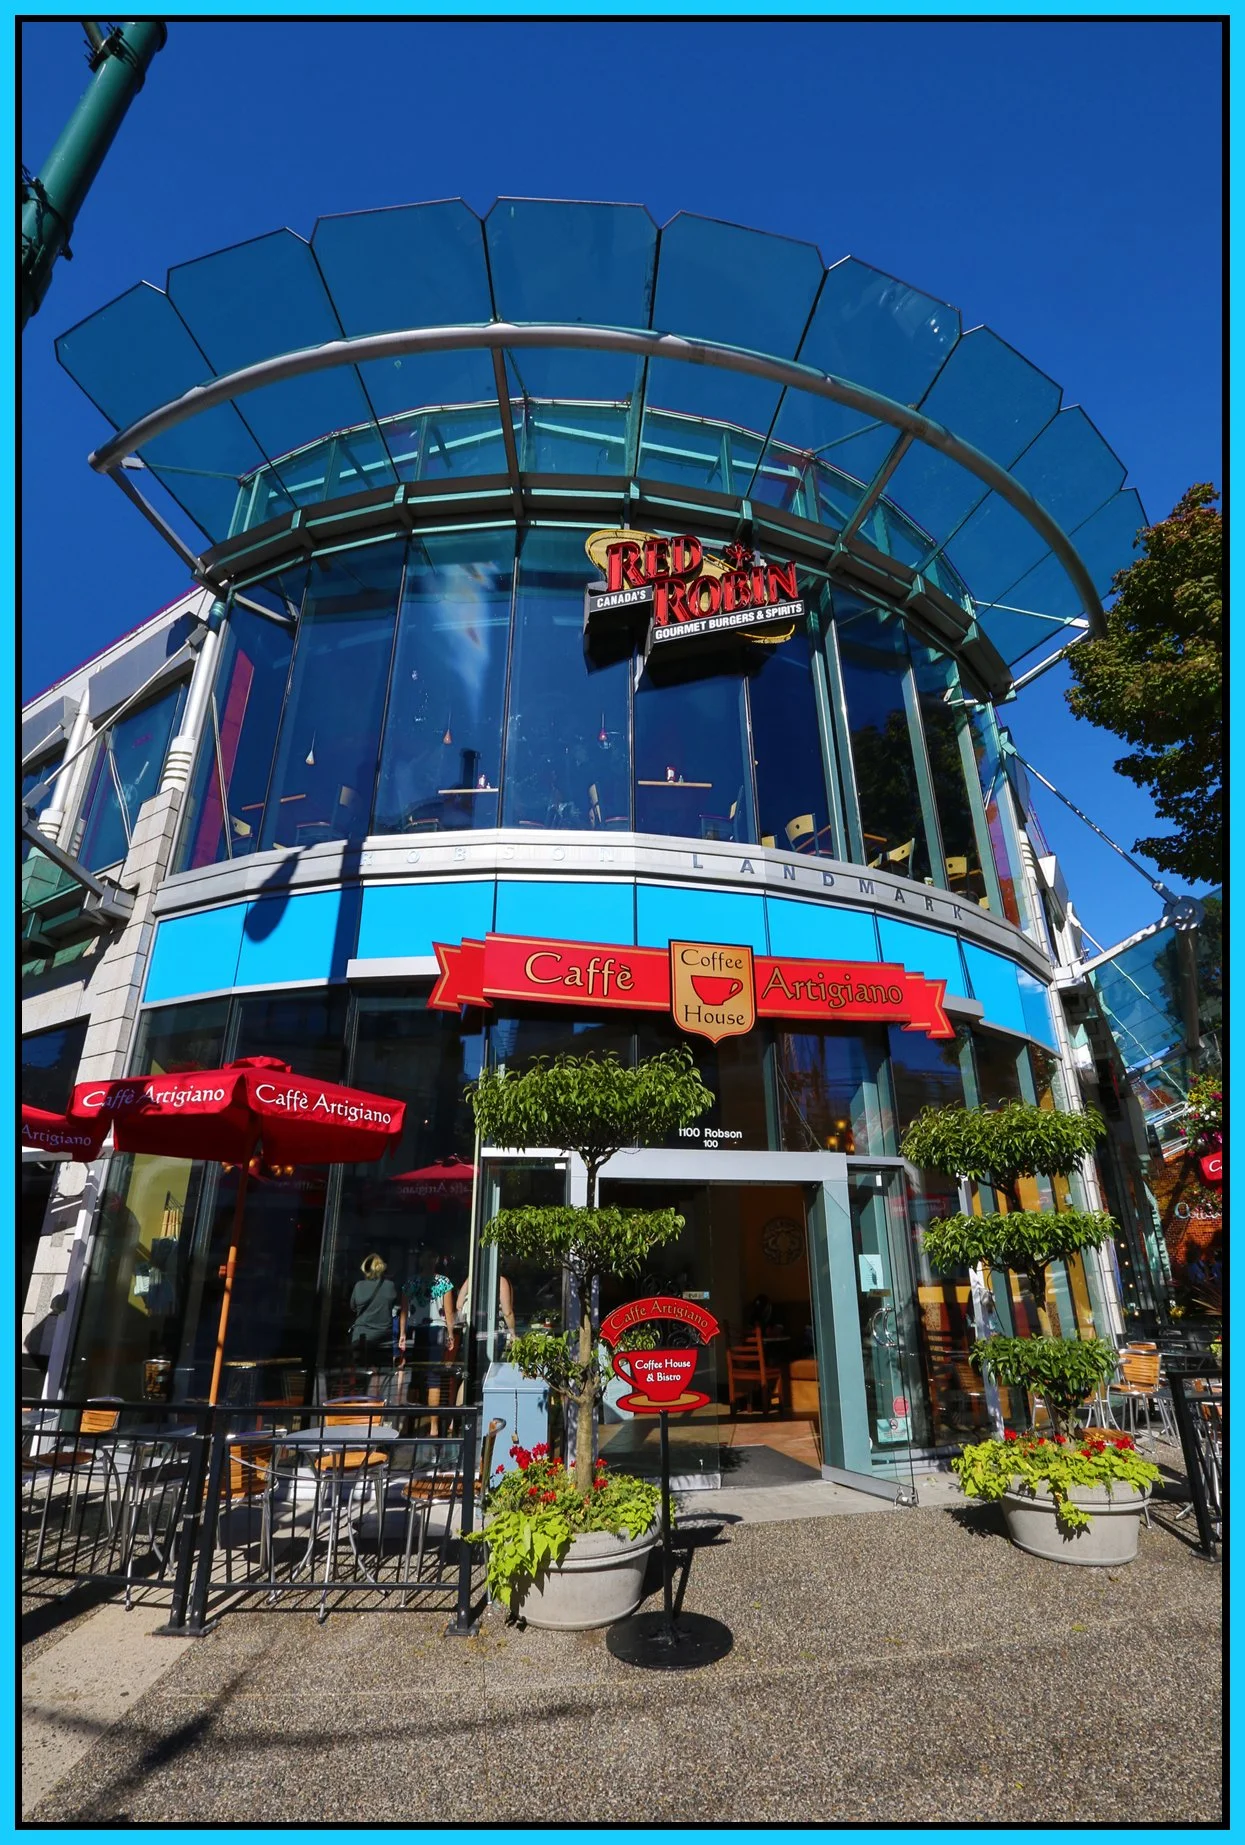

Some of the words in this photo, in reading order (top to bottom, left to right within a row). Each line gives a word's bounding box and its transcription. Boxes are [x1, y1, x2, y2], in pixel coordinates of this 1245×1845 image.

[606, 534, 704, 593] RED
[596, 589, 647, 608] CANADA'S
[652, 560, 799, 627] ROBIN
[655, 620, 707, 641] GOURMET
[708, 610, 755, 630] BURGERS
[756, 610, 765, 620] &
[765, 602, 803, 620] SPIRITS
[360, 846, 615, 867] ROBSON
[692, 853, 963, 921] LANDMARK
[680, 948, 744, 971] Coffee
[524, 950, 635, 997] Caffè
[761, 966, 904, 1009] Artigiano
[684, 1004, 746, 1026] House
[82, 1088, 136, 1110] Caffè
[137, 1085, 225, 1108] Artigiano
[255, 1084, 309, 1111] Caffè
[311, 1093, 392, 1125] Artigiano
[678, 1127, 701, 1138] 1100
[704, 1128, 743, 1139] Robson
[703, 1139, 719, 1148] 100
[650, 1300, 708, 1328] Artigiano
[635, 1360, 663, 1371] Coffee
[664, 1358, 691, 1368] House
[646, 1373, 655, 1382] &
[656, 1371, 681, 1382] Bistro
